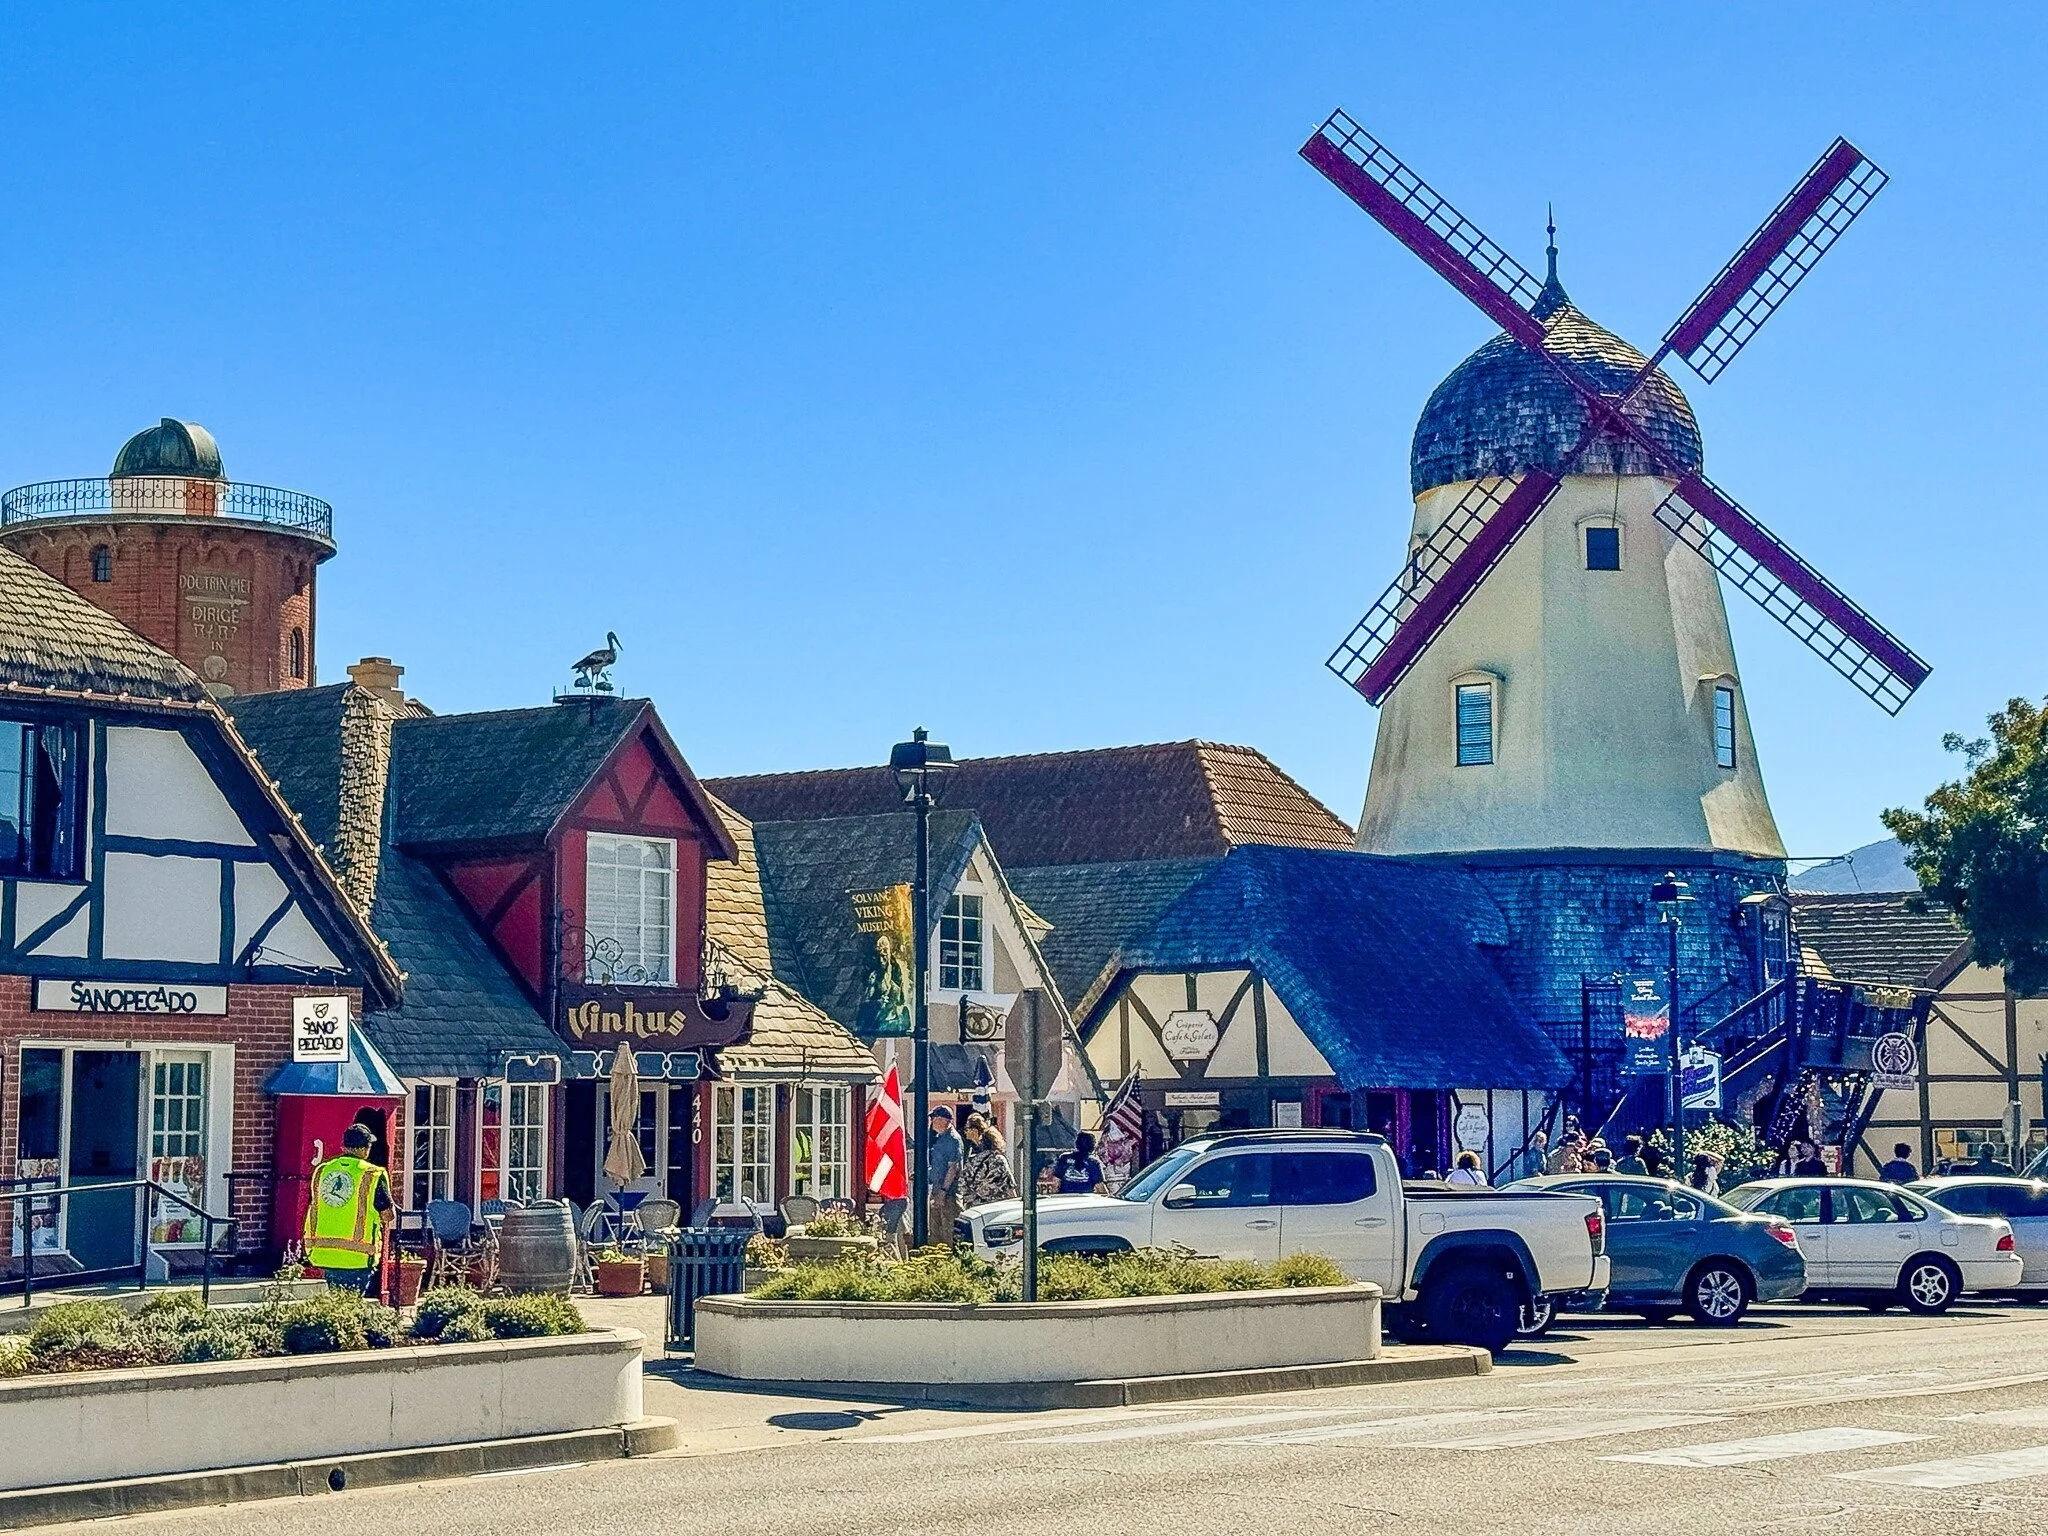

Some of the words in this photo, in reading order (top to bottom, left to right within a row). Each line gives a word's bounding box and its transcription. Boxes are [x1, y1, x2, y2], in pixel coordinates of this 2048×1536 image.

[192, 606, 240, 624] DIRIGE
[211, 640, 223, 651] IN
[852, 891, 891, 904] SOLVANG
[855, 905, 893, 919] VIKING
[857, 920, 894, 933] MUSEUM
[70, 981, 197, 1014] SANOPECADO
[568, 1000, 687, 1040] Vinhus
[298, 1035, 343, 1050] PECADO
[692, 1094, 702, 1144] 440
